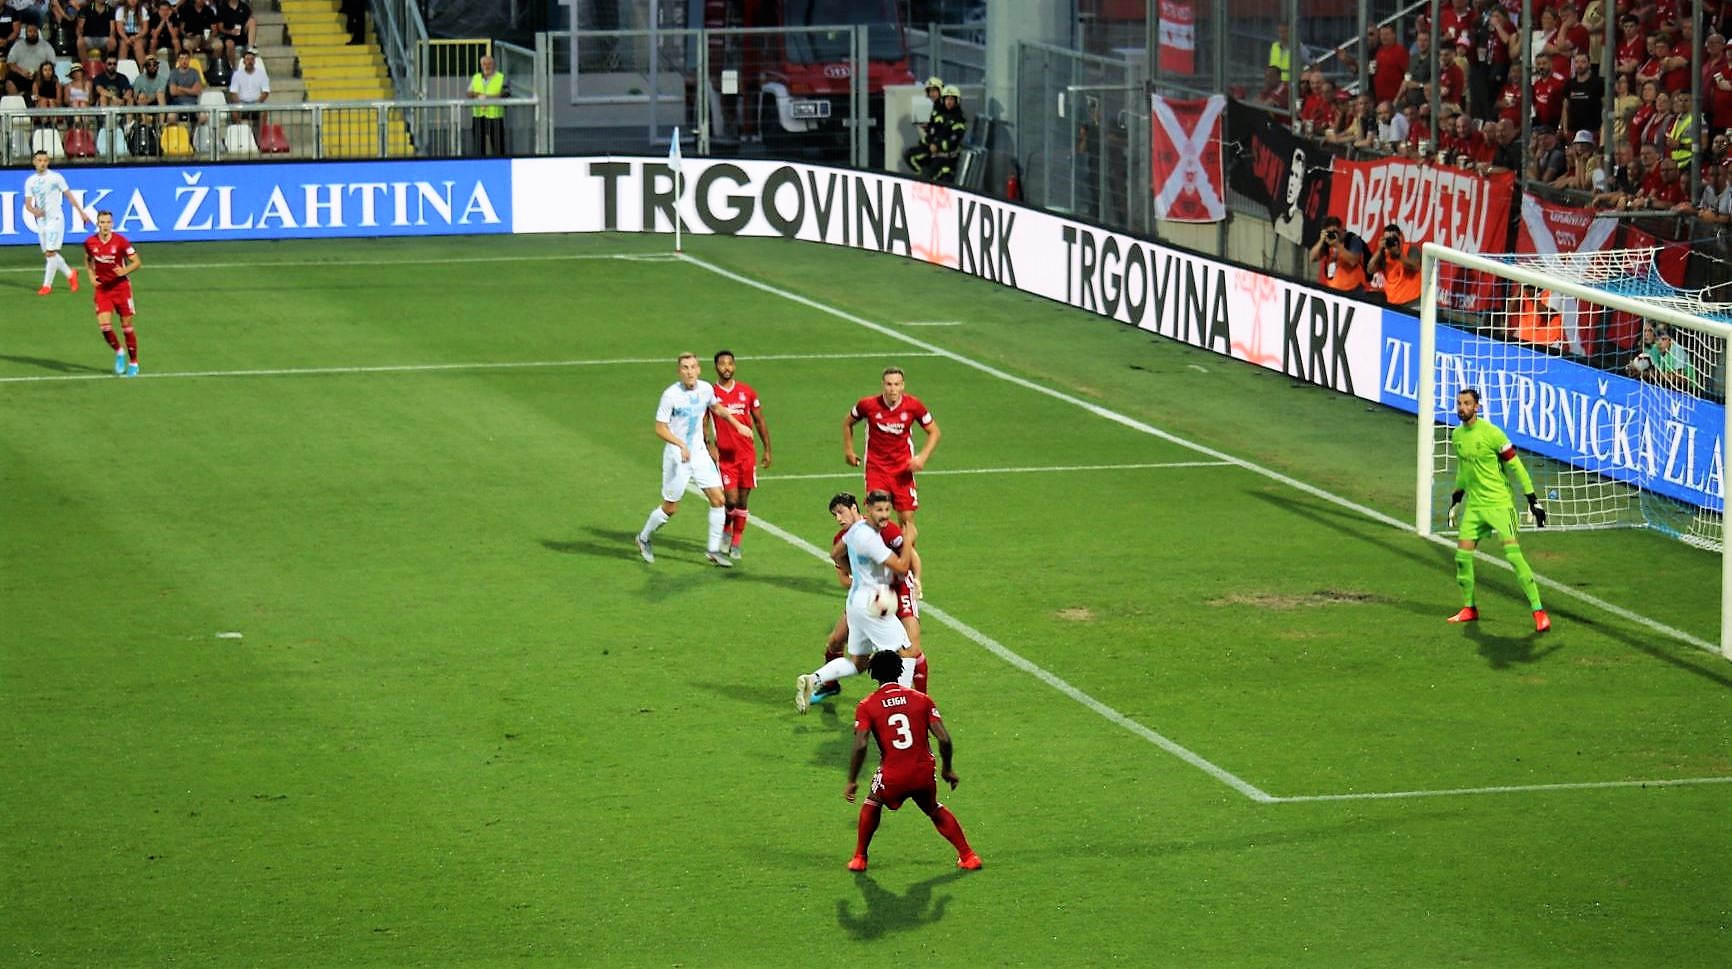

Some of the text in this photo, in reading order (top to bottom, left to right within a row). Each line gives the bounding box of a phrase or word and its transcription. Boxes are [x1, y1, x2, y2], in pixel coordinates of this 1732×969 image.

[174, 171, 502, 231] ŽLAHTINA
[589, 161, 1017, 288] TRGOVINA KRK
[1063, 225, 1355, 394] TRGOVINA KRK
[1384, 337, 1491, 423] ZLTNA
[1495, 369, 1657, 478] VRBNIČKA
[881, 696, 907, 708] LEIGH
[887, 712, 914, 750] 3
